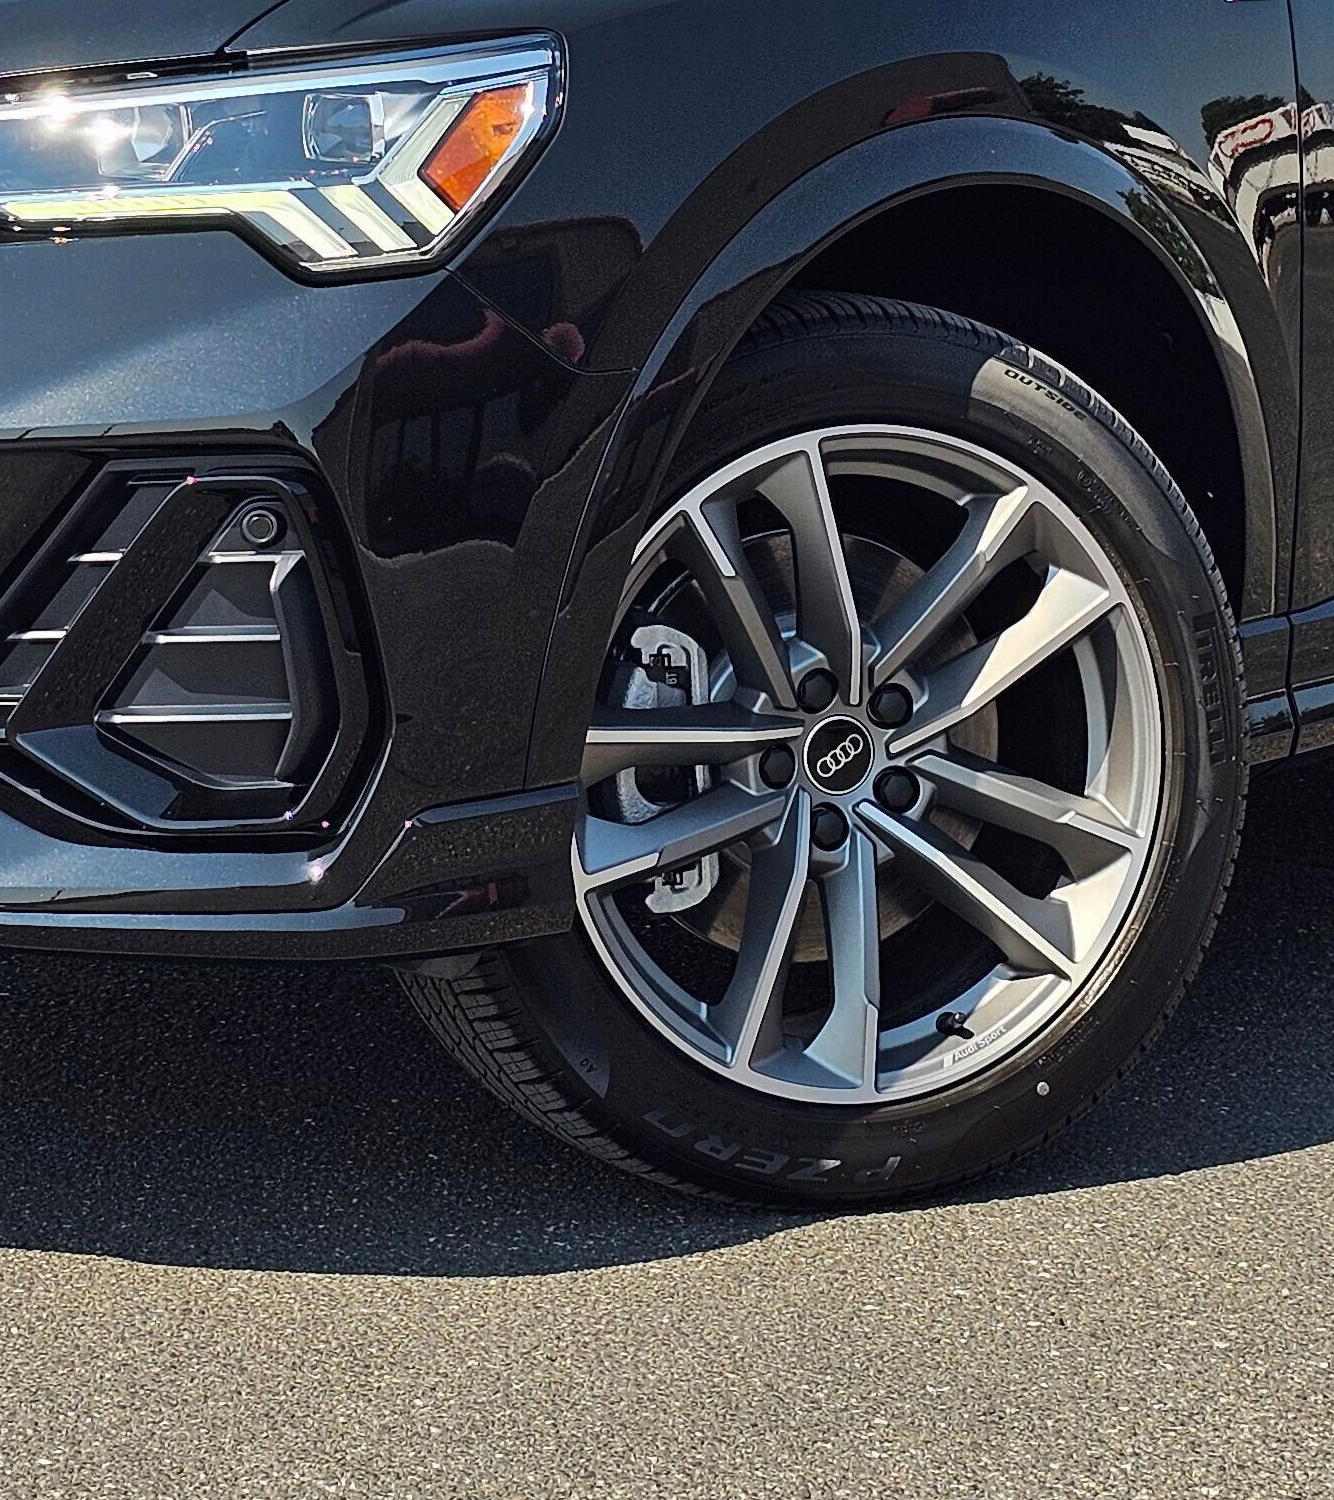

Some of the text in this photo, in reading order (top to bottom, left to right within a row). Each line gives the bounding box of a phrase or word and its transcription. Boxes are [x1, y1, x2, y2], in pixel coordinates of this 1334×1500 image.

[1004, 368, 1087, 421] OUTSIDE
[954, 1025, 1007, 1060] Audi Sport
